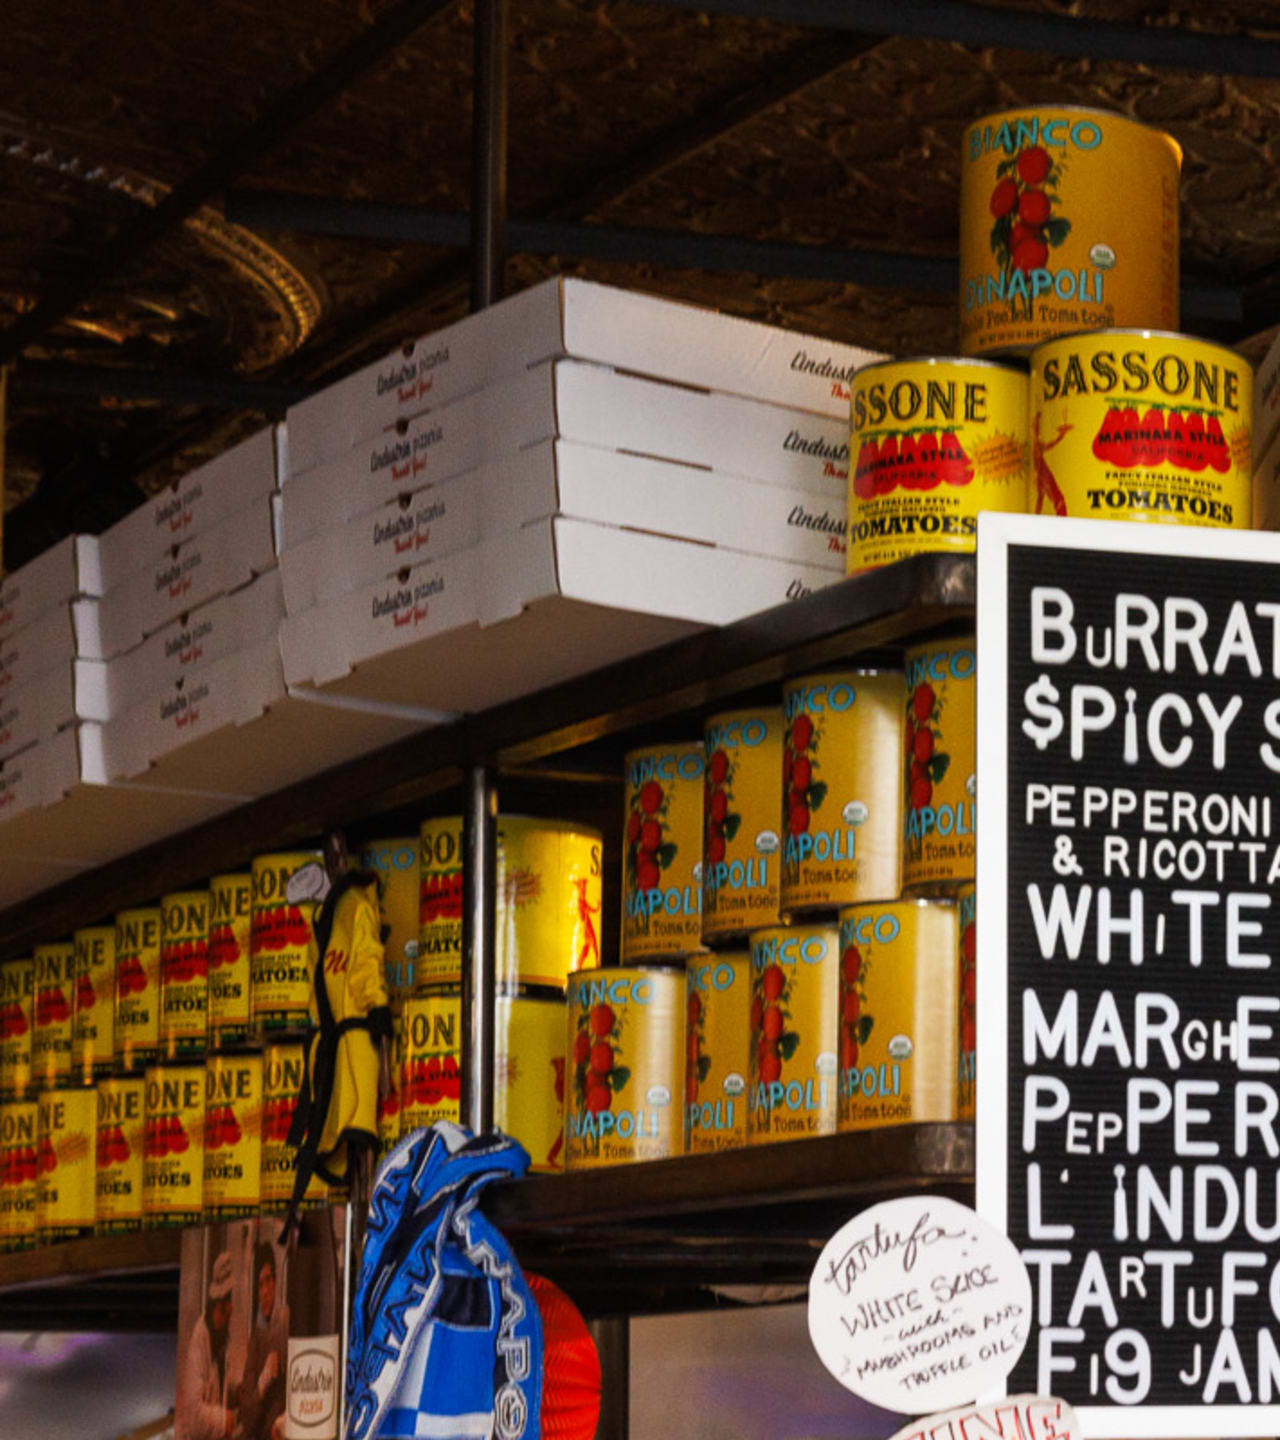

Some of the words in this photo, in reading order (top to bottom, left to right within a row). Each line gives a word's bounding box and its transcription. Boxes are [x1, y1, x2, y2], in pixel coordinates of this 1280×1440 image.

[969, 116, 1103, 162] BIANCO
[1042, 349, 1239, 412] SASSONE
[1189, 431, 1224, 447] STYLE
[1087, 488, 1233, 524] TOMATOES
[1026, 784, 1270, 837] PEPPERONI
[1053, 835, 1083, 875] &
[1027, 884, 1271, 968] WHITE
[840, 1288, 923, 1338] WHITE
[931, 1263, 999, 1305] SLICE
[856, 1325, 977, 1381] MUSHROOMS
[983, 1303, 1024, 1330] AND
